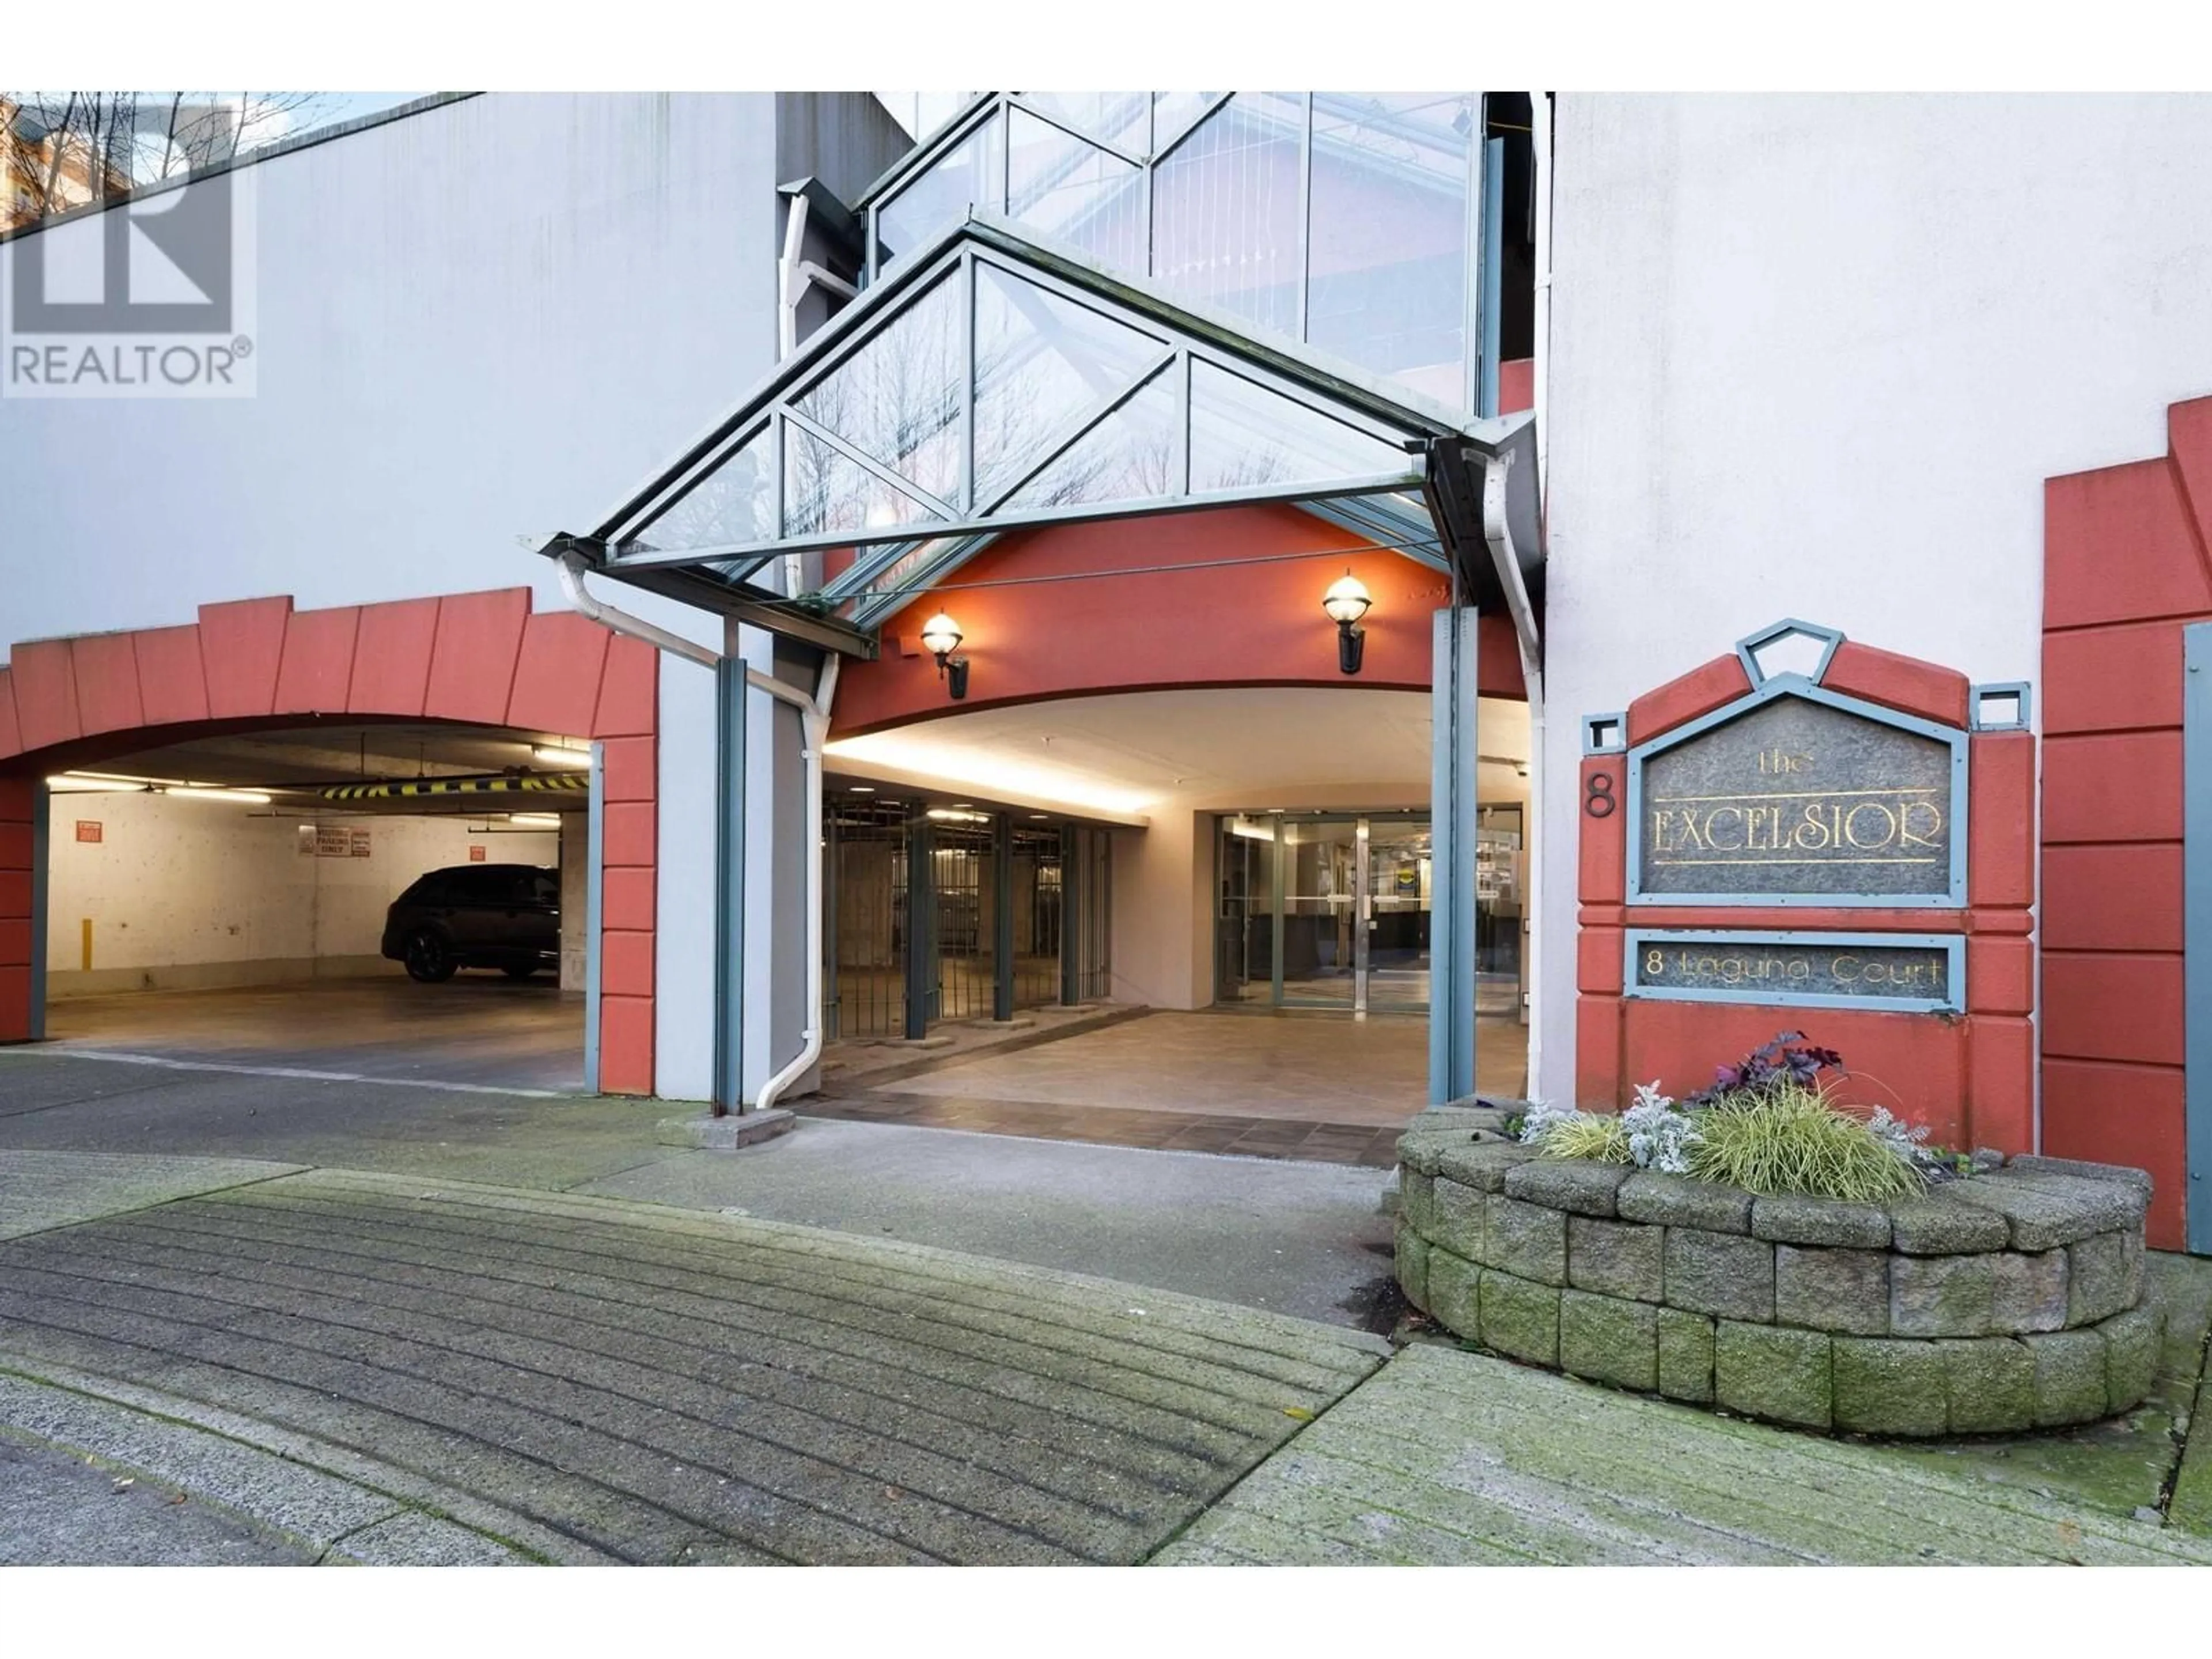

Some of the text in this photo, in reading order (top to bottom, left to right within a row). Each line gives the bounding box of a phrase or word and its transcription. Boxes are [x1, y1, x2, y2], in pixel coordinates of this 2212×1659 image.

[1758, 747, 1814, 775] the
[1585, 772, 1616, 818] 8
[1653, 801, 1942, 853] EXCELSIOR
[1646, 950, 1942, 986] 8 Laguna Court
